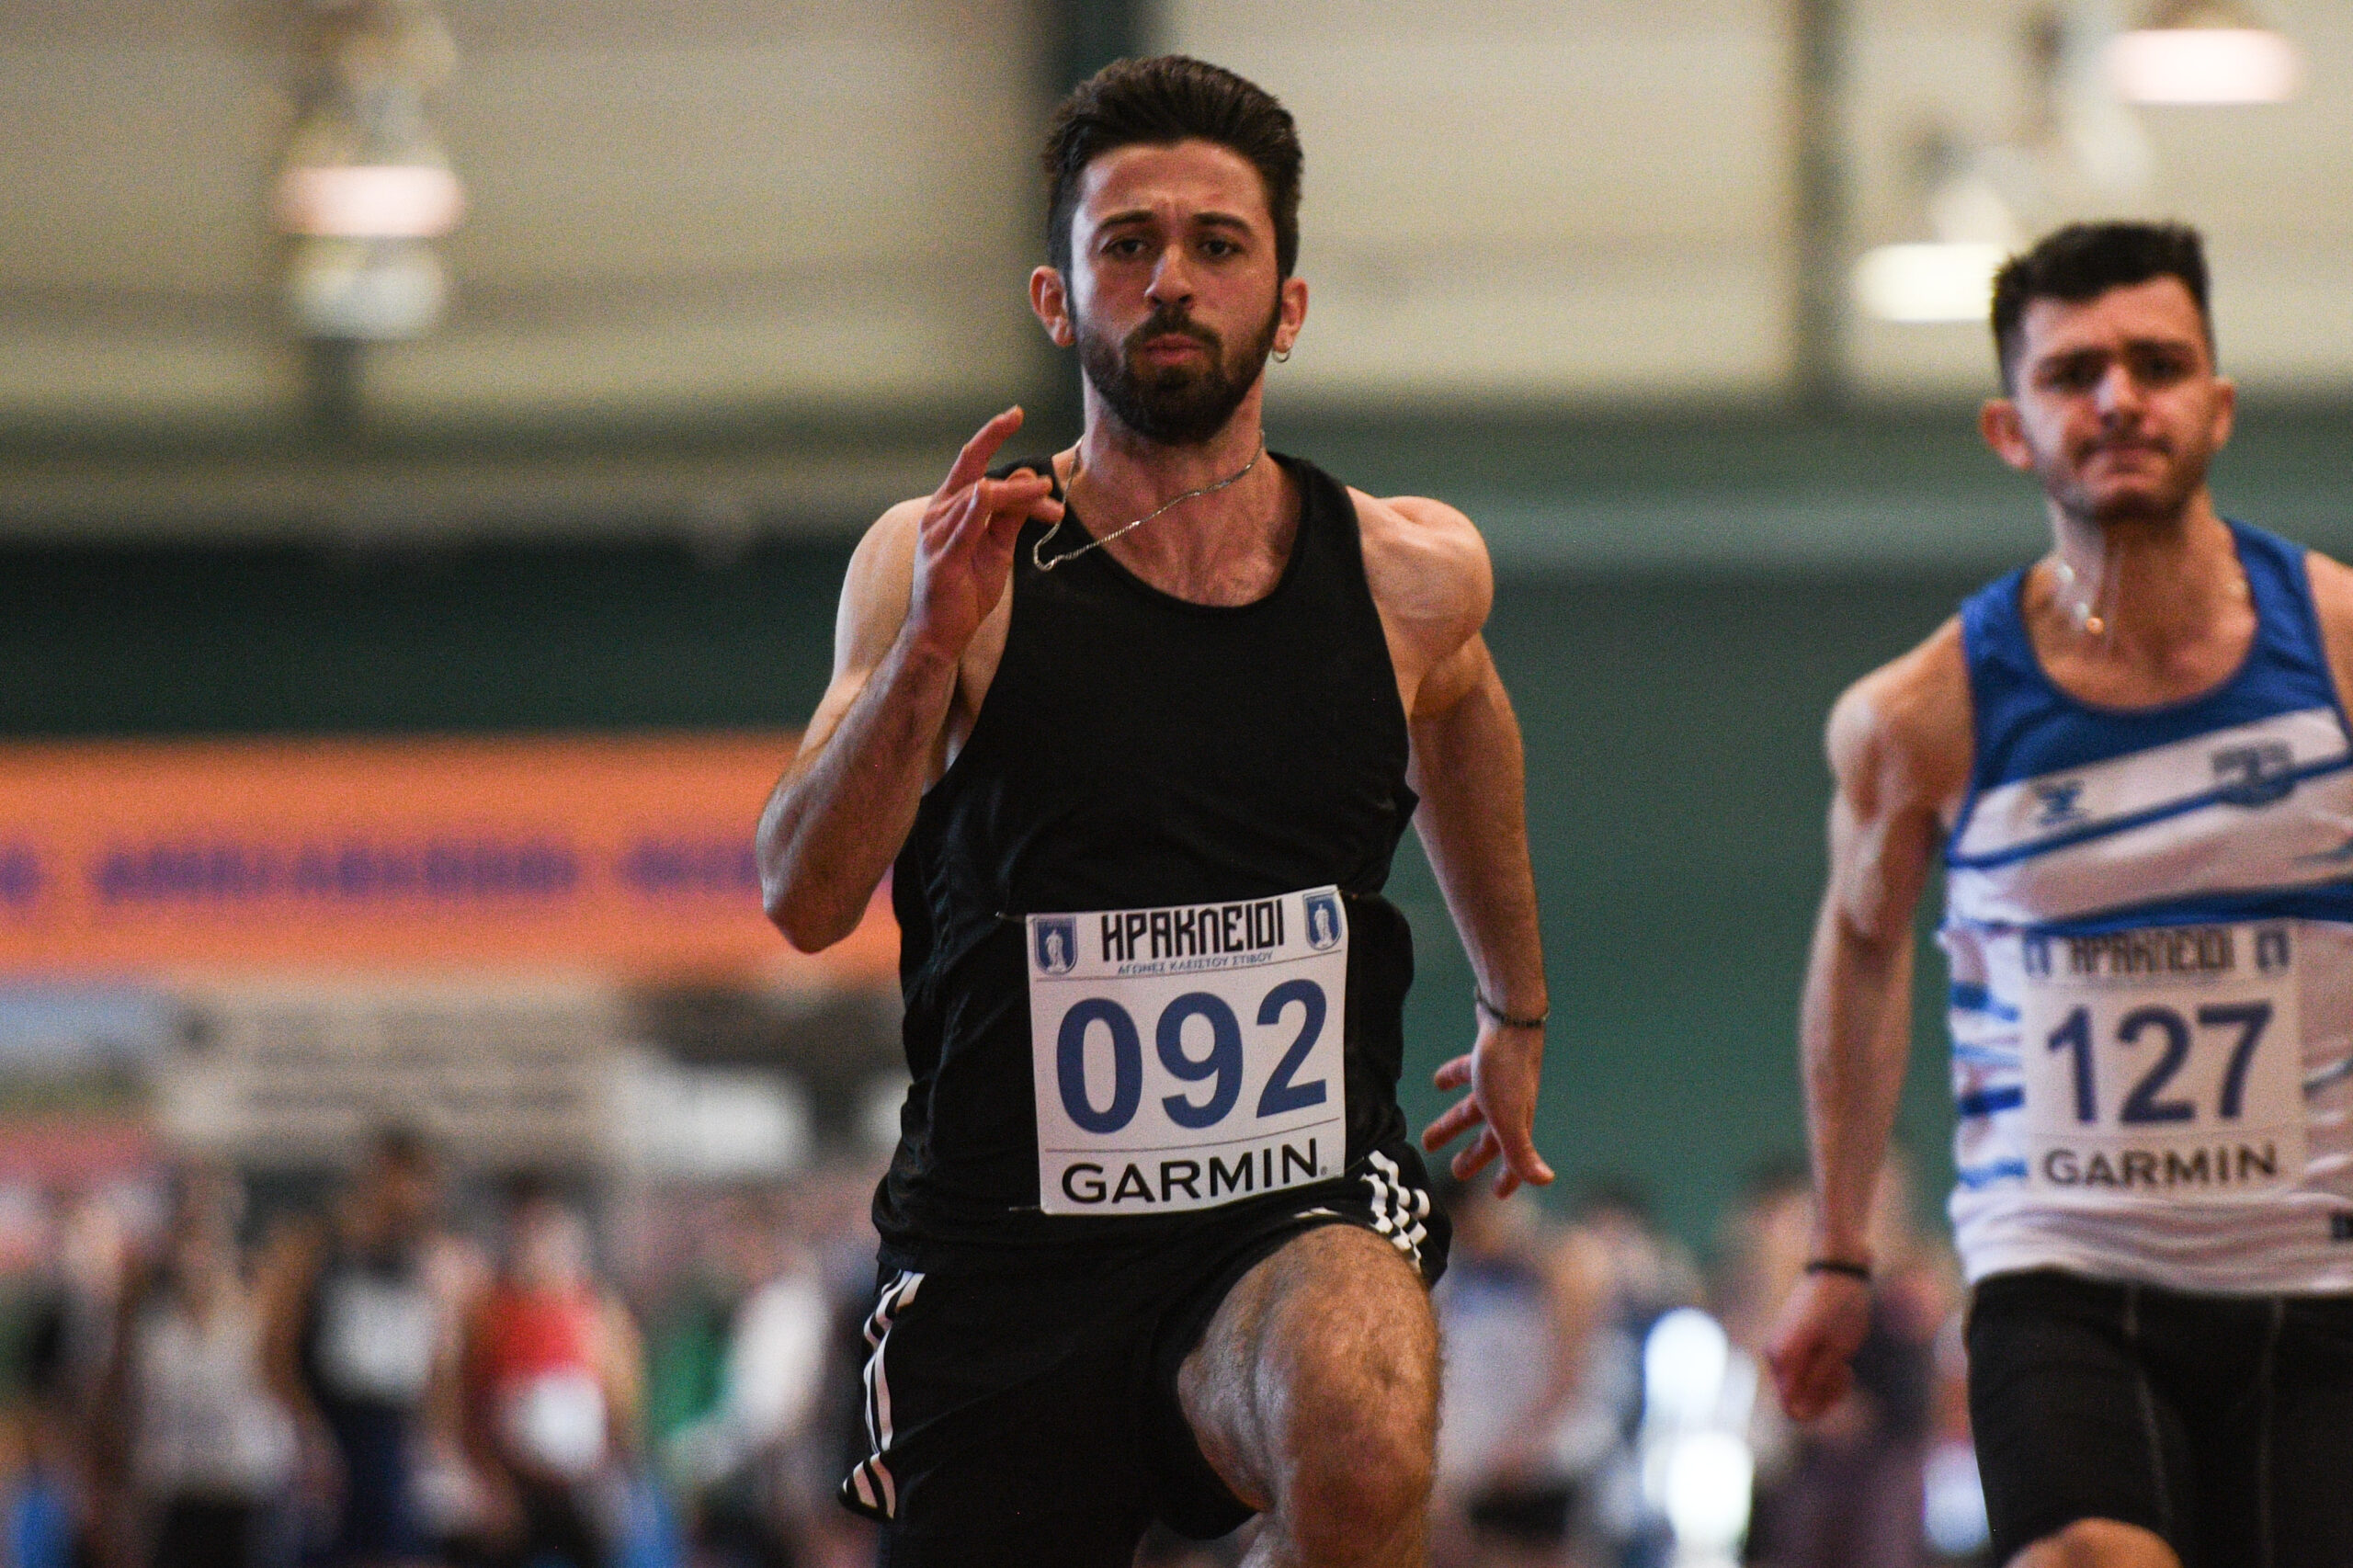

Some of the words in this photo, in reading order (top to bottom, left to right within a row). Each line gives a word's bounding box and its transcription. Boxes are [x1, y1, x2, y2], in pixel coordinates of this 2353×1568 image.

[1056, 978, 1327, 1135] 092
[2047, 1002, 2273, 1124] 127
[1062, 1138, 1317, 1204] GARMIN
[2043, 1142, 2279, 1189] GARMIN
